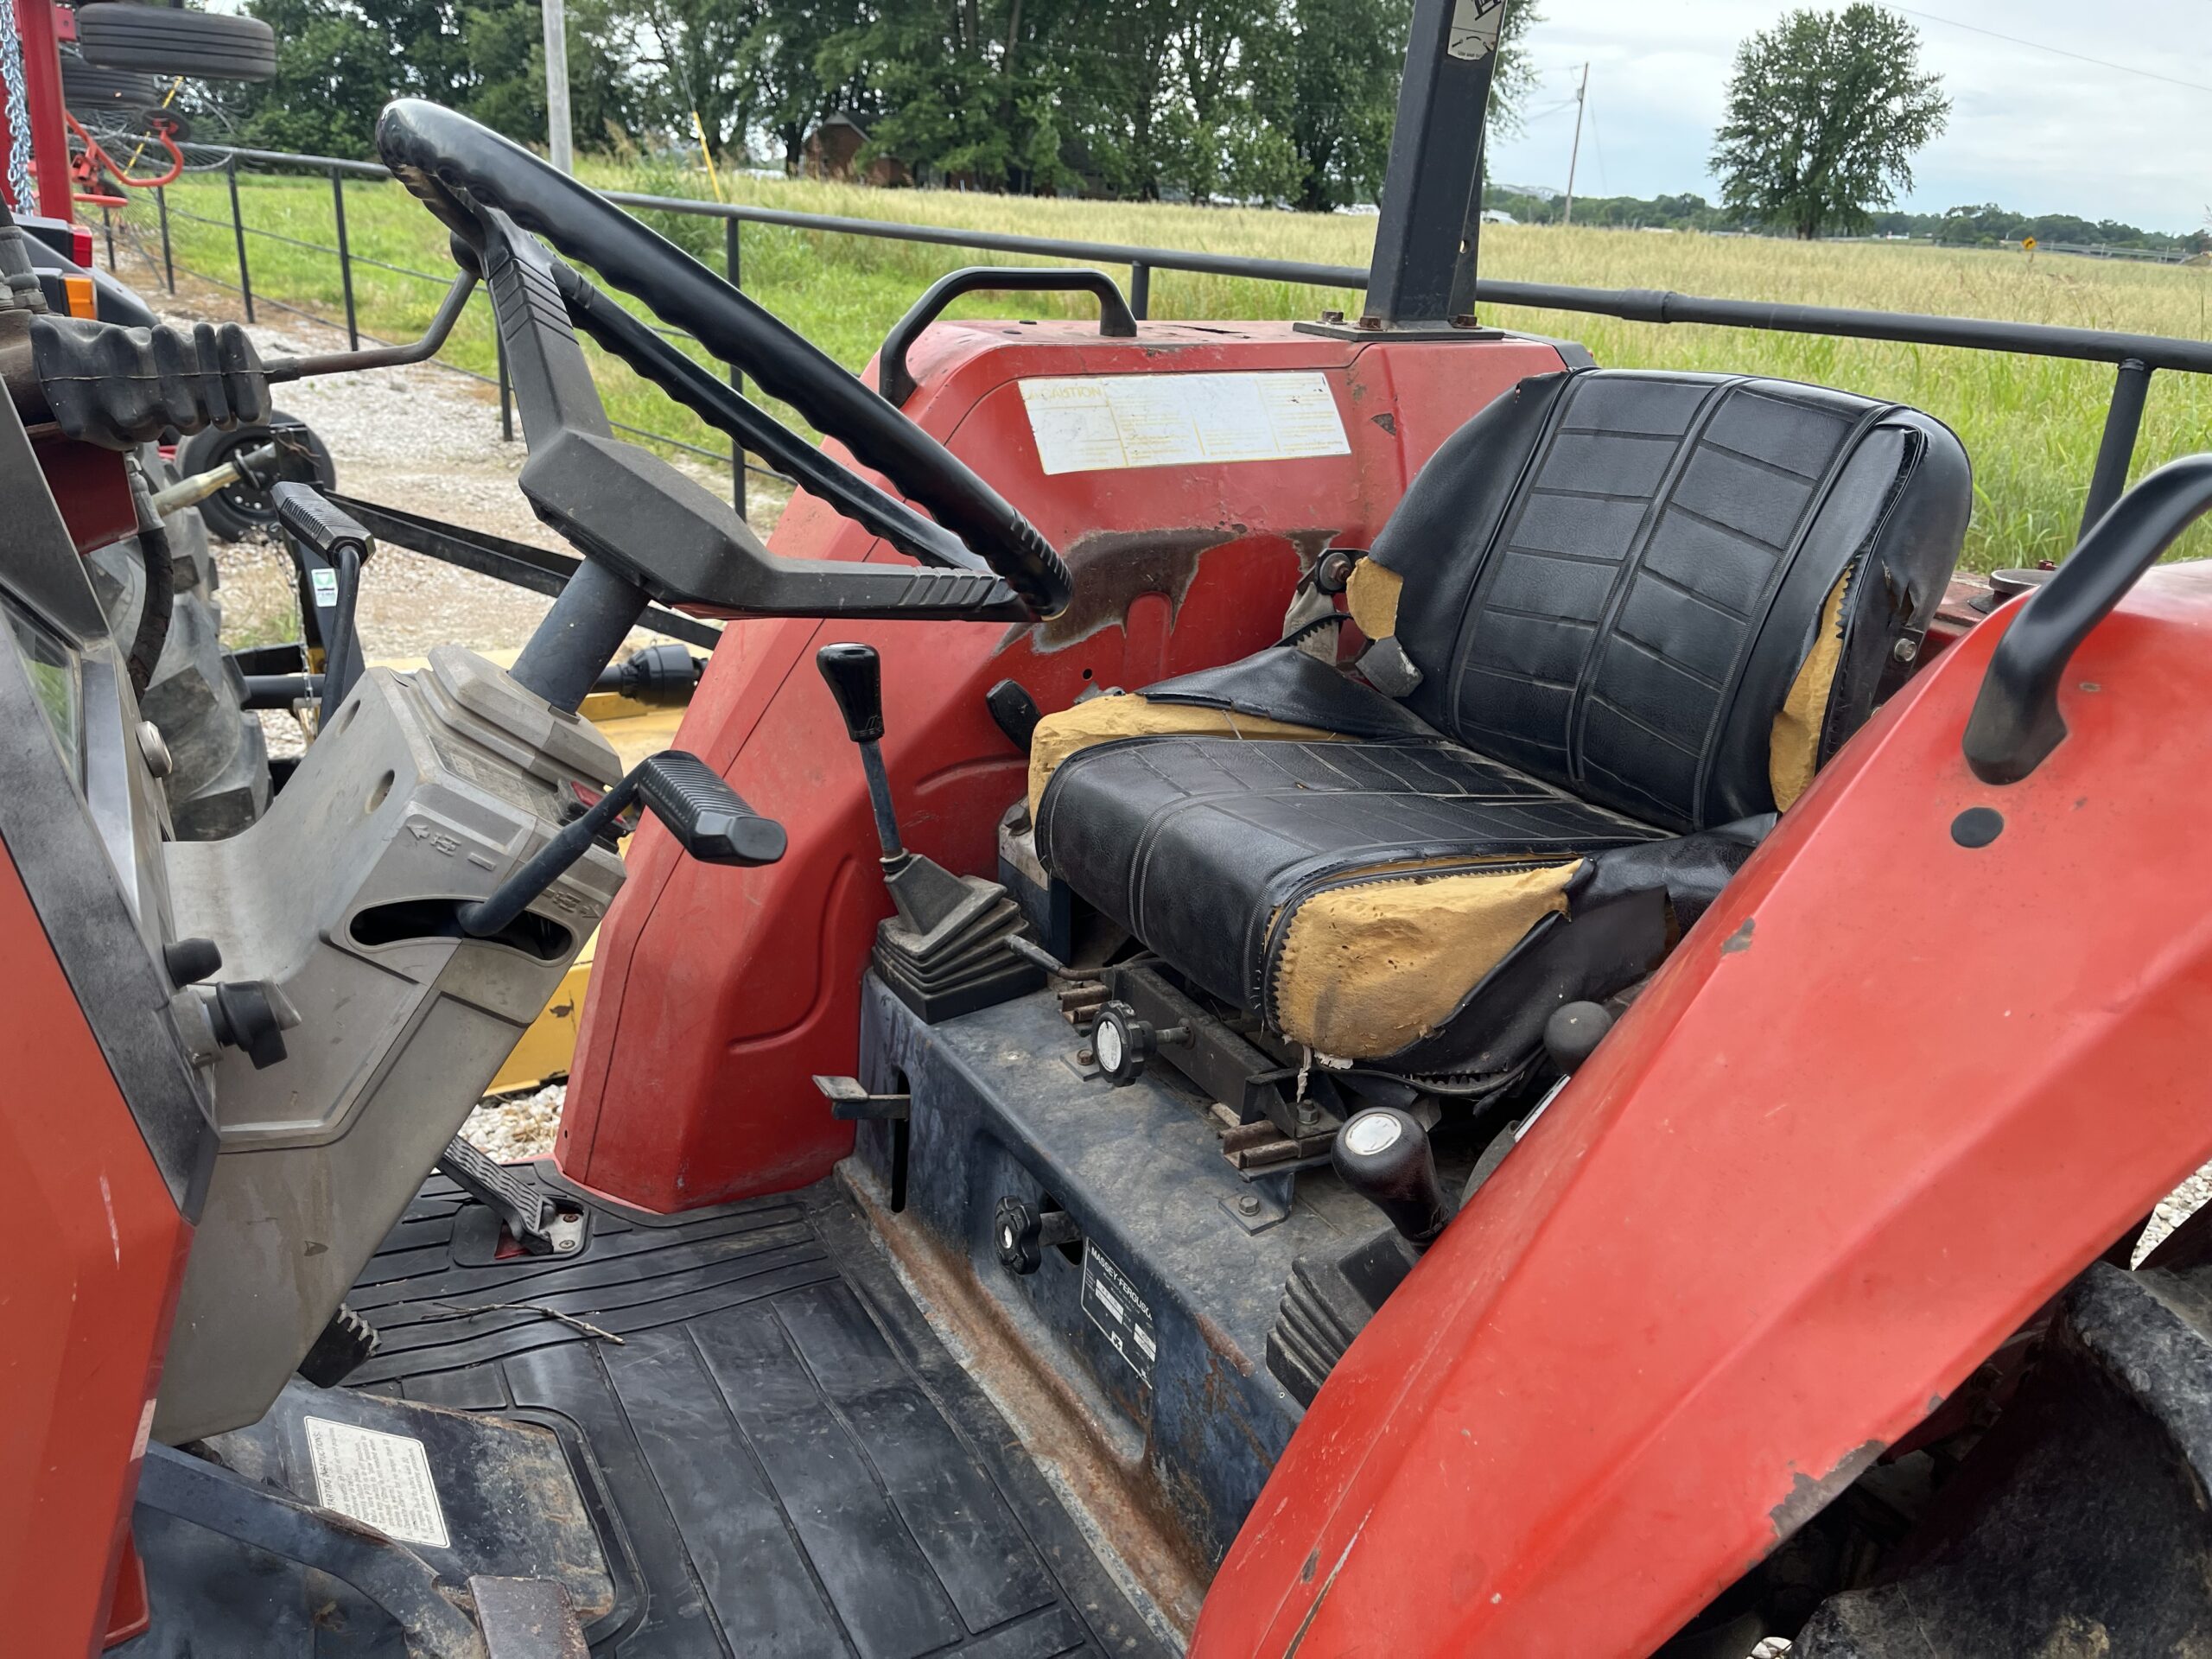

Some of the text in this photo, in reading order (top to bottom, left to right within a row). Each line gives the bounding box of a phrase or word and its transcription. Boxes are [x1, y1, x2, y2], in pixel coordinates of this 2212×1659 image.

[1041, 385, 1103, 401] CAUTION
[1091, 1246, 1153, 1321] MASSEY-FERGUSO
[321, 1478, 337, 1511] STARTING
